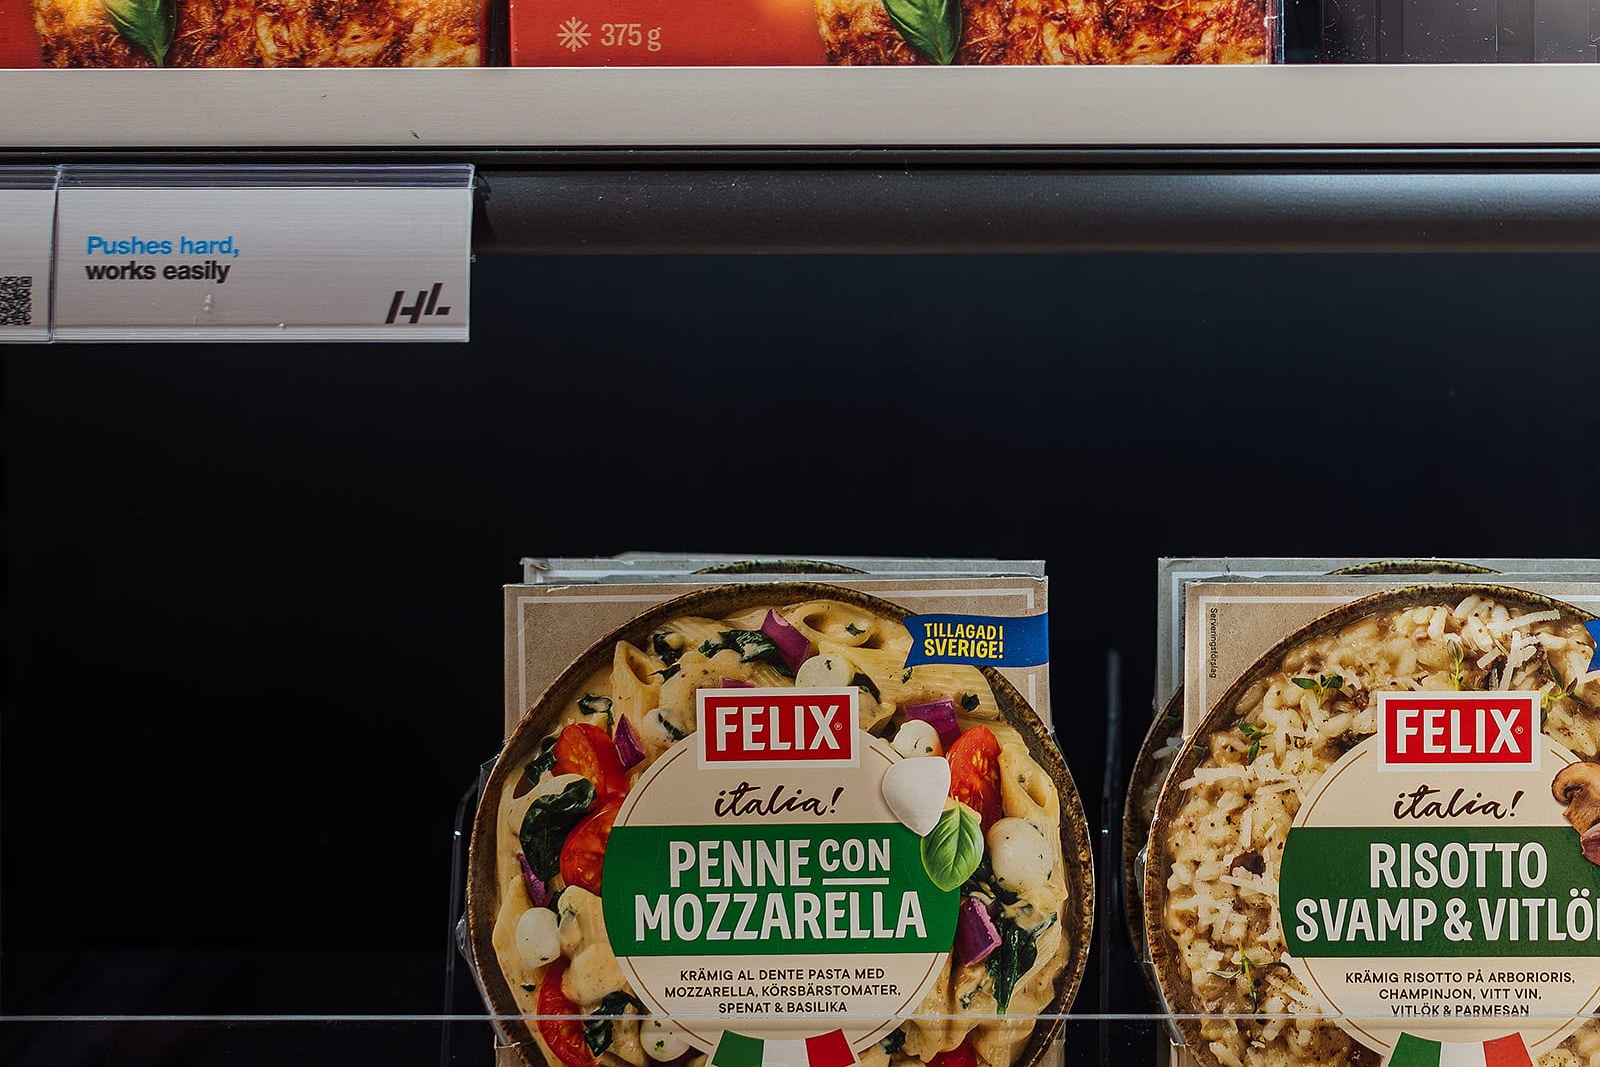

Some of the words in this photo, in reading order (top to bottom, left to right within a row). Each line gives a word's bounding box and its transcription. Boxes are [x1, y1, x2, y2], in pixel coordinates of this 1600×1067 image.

[600, 23, 643, 47] 375
[647, 26, 662, 52] g
[86, 235, 172, 256] Pushes
[179, 235, 240, 258] hard,
[85, 261, 157, 281] works
[162, 260, 231, 284] easily
[924, 622, 997, 640] TILLAGAD
[1209, 607, 1218, 679] Serveringsförslag
[924, 638, 1004, 659] SVERIGE!
[715, 705, 840, 752] FELIX
[1396, 708, 1521, 755] FELIX
[714, 781, 844, 817] italia!
[1393, 784, 1525, 820] italia!
[669, 839, 812, 888] PENNE
[818, 838, 891, 871] CON
[1370, 842, 1548, 889] RISOTTO
[634, 891, 927, 942] MOZZARELLA
[1296, 898, 1438, 942] SVAMP
[1443, 898, 1473, 942] &
[680, 967, 733, 981] KRÄMIG
[737, 969, 755, 981] AL
[759, 969, 804, 981] DENTE
[808, 968, 850, 980] PASTA
[854, 968, 884, 980] MED
[1345, 970, 1399, 983] KRÄMIG
[1403, 972, 1463, 983] RISOTTO
[1467, 969, 1485, 983] PÅ
[1488, 972, 1575, 984] ARBORIORIS,
[664, 985, 759, 998] MOZZARELLA,
[762, 983, 901, 998] KÖRSBÄRSTOMATER,
[1379, 988, 1476, 1001] CHAMPINJON,
[1480, 988, 1510, 999] VITT
[1514, 988, 1542, 1000] VIN,
[718, 1002, 770, 1014] SPENAT
[774, 1002, 784, 1013] &
[787, 1001, 848, 1014] BASILIKA
[1391, 1002, 1439, 1016] VITLÖK
[1443, 1004, 1451, 1016] &
[1455, 1004, 1530, 1016] PARMESAN
